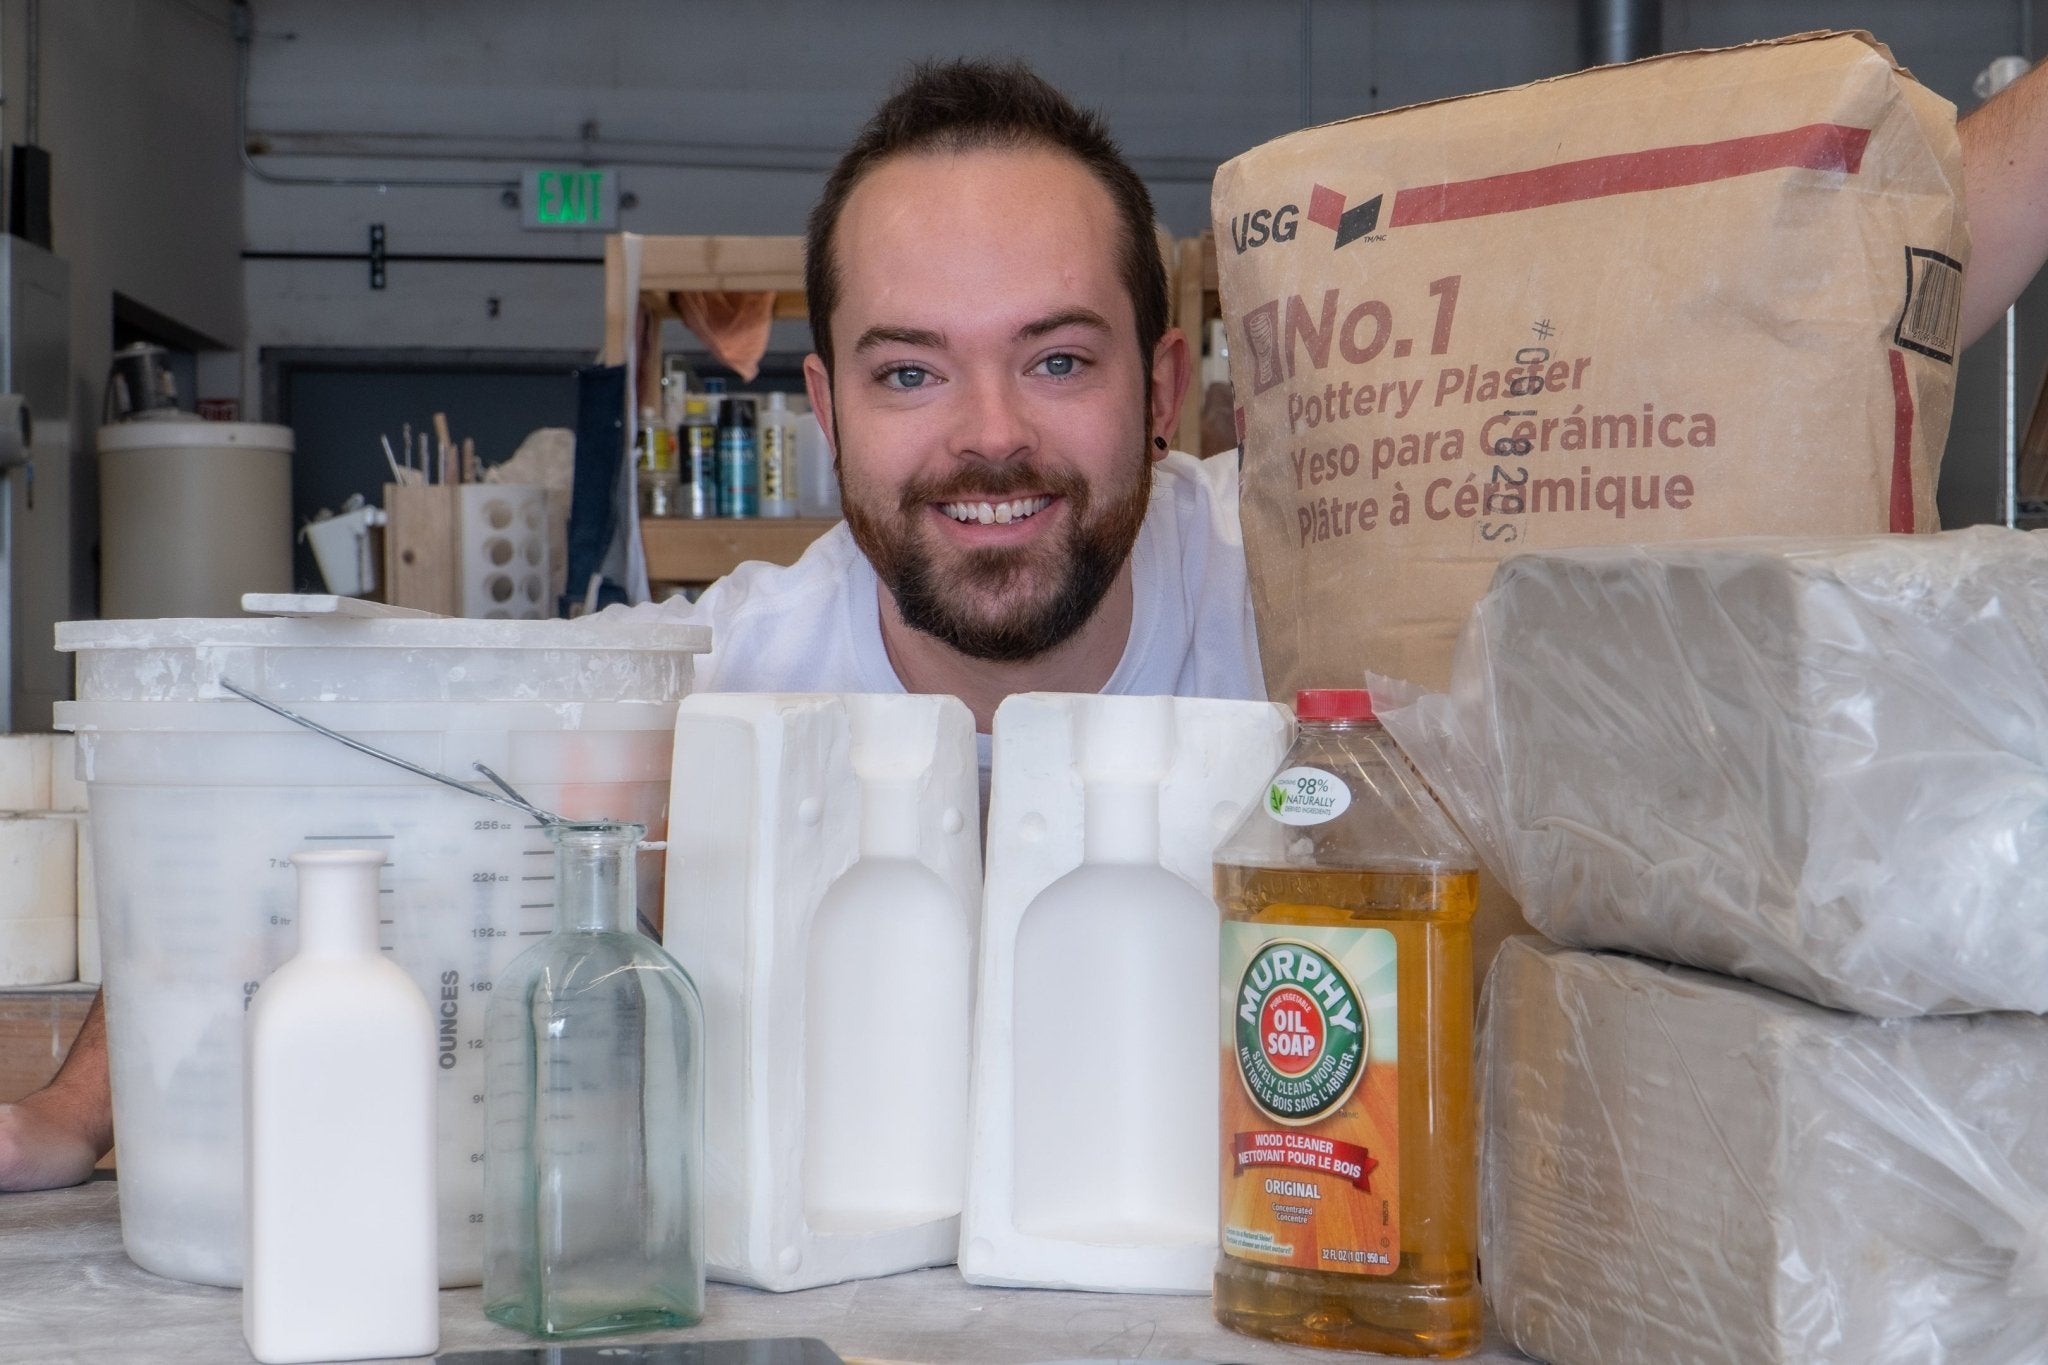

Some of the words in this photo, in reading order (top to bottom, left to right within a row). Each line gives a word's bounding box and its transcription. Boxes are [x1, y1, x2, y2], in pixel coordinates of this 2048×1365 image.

[538, 171, 603, 223] EXIT
[1231, 204, 1299, 255] USG
[1285, 275, 1461, 378] No.1
[1289, 379, 1424, 434] Pottery
[1434, 356, 1591, 408] Plaster
[1291, 443, 1360, 490] Yeso
[1372, 428, 1464, 480] para
[1480, 403, 1716, 456] Cerámica
[1298, 497, 1379, 549] Plâtre
[1390, 481, 1410, 526] à
[1424, 466, 1694, 520] Céramique
[1297, 777, 1328, 795] 98%
[1287, 795, 1335, 807] NATURALLY
[474, 821, 498, 830] 256
[269, 858, 276, 868] 7
[472, 872, 496, 882] 224
[270, 915, 278, 925] 6
[471, 927, 495, 937] 192
[469, 981, 493, 991] 160
[1240, 950, 1357, 1033] MURPHY
[1282, 993, 1312, 1013] VEGETABLE
[439, 969, 459, 1070] OUNCES
[1273, 1009, 1309, 1033] OIL
[467, 1039, 484, 1049] 12
[1268, 1032, 1315, 1056] SOAP
[1240, 1046, 1263, 1092] NETTOIE
[1261, 1087, 1272, 1102] LE
[1272, 1094, 1292, 1112] BOIS
[1295, 1093, 1320, 1112] SANS
[1319, 1052, 1355, 1101] L'ABÎMER
[1252, 1051, 1276, 1087] SAFELY
[1277, 1079, 1312, 1095] CLEANS
[1312, 1054, 1336, 1086] WOOD
[1255, 1134, 1283, 1147] WOOD
[1285, 1135, 1333, 1154] CLEANER
[1238, 1149, 1285, 1165] NETTOYANT
[1288, 1151, 1315, 1166] POUR
[1318, 1155, 1331, 1169] LE
[1334, 1159, 1361, 1178] BOIS
[1265, 1179, 1321, 1199] ORIGINAL
[469, 1213, 484, 1223] 32
[1271, 1203, 1313, 1215] Concentrated
[1276, 1213, 1308, 1224] Concentré
[1322, 1248, 1329, 1259] 32
[1330, 1250, 1337, 1260] FL
[1338, 1250, 1346, 1261] OZ
[1367, 1252, 1378, 1263] 950
[1379, 1253, 1389, 1264] mL
